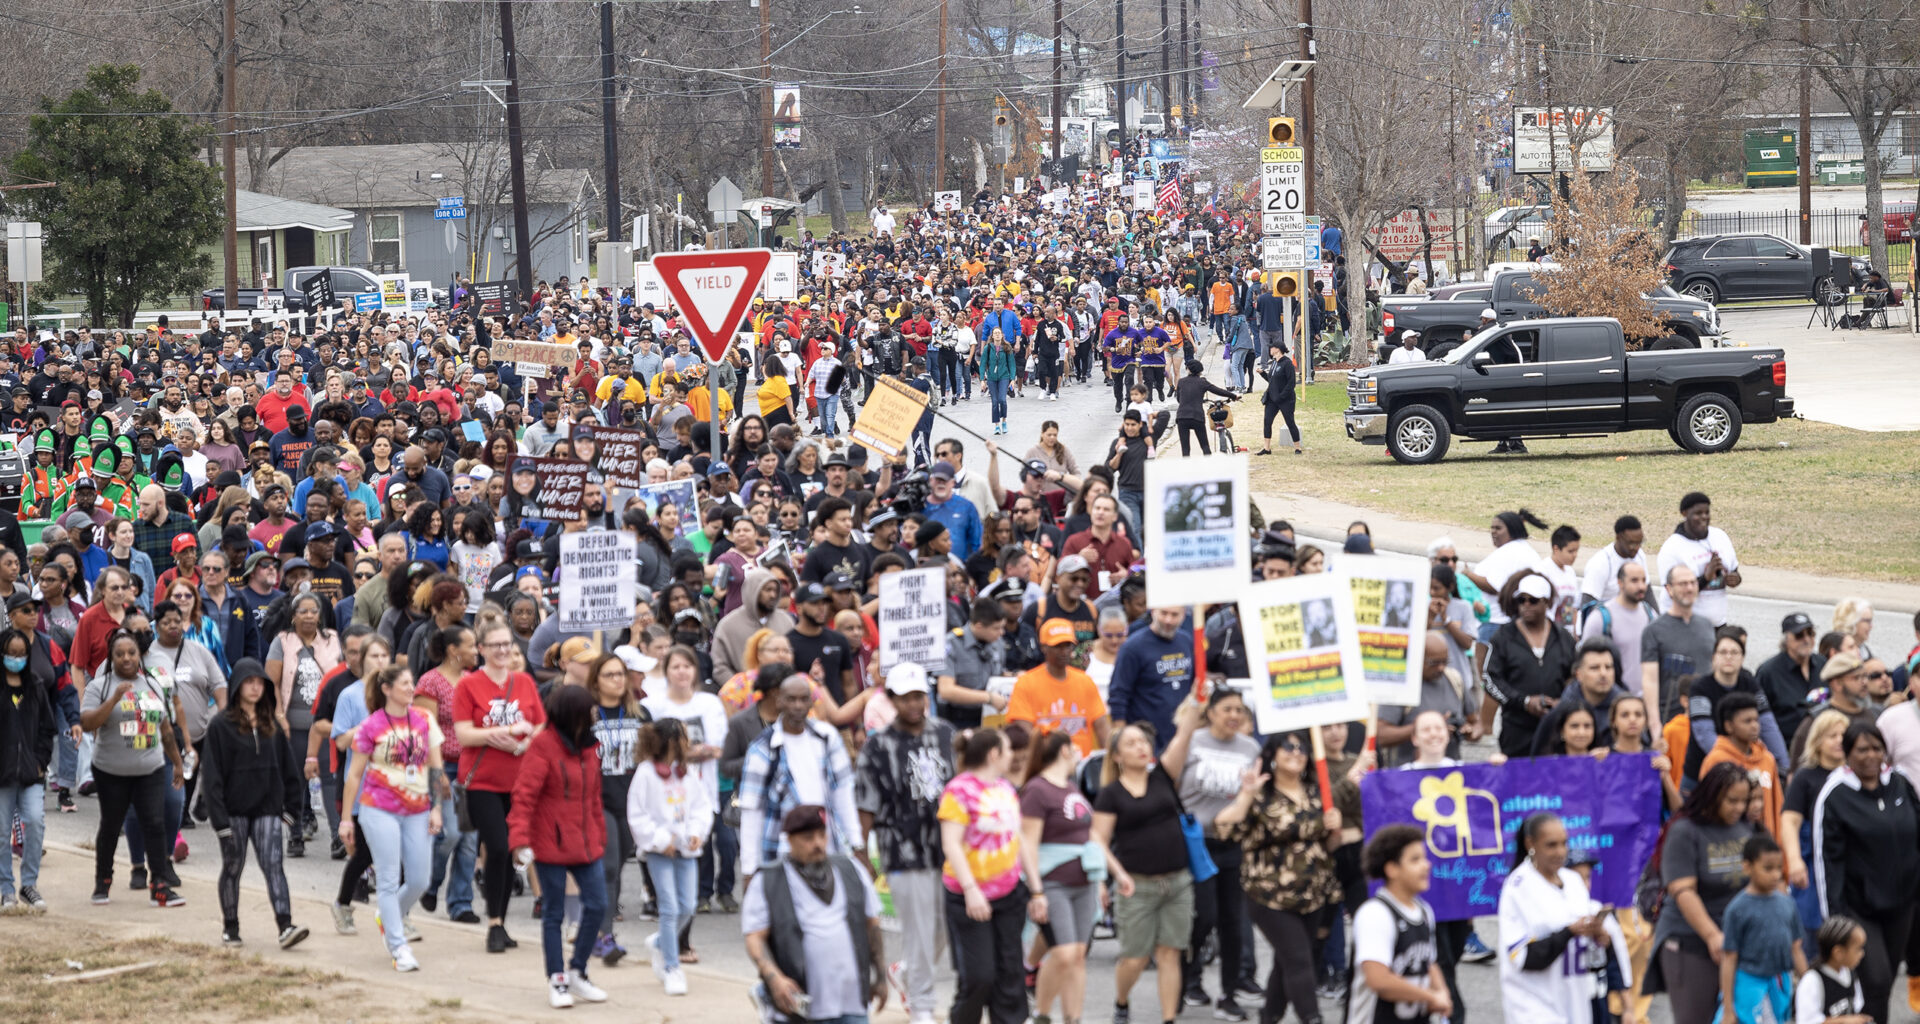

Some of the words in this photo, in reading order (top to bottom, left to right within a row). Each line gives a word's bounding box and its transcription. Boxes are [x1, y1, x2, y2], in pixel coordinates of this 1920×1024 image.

[1264, 150, 1300, 160] SCHOOL
[1266, 165, 1300, 173] SPEED
[1269, 177, 1296, 185] LIMIT
[1268, 189, 1299, 210] 20
[1391, 225, 1408, 234] Title
[694, 276, 732, 289] YIELD
[514, 345, 555, 365] PEACE
[595, 432, 640, 442] REMEMBER
[282, 442, 312, 451] WHISKEY
[603, 443, 637, 457] HER
[537, 464, 588, 473] REMEMBER
[597, 457, 639, 474] NAME!
[544, 475, 583, 489] HER
[586, 472, 604, 484] Eva
[536, 489, 582, 506] NAME!
[521, 506, 540, 517] Eva
[543, 508, 579, 519] Mireles
[579, 535, 617, 549] DEFEND
[563, 549, 632, 565] DEMOCRATIC
[579, 565, 618, 579] RIGHTS!
[900, 575, 926, 588] FIGHT
[1350, 578, 1383, 590] STOP
[582, 584, 617, 595] DEMAND
[588, 597, 617, 607] WHOLE
[905, 590, 921, 603] THE
[1359, 595, 1381, 608] THE
[569, 609, 587, 621] NEW
[592, 607, 627, 619] SYSTEM!
[884, 606, 912, 620] THREE
[917, 603, 942, 618] EVILS
[1260, 604, 1296, 619] STOP
[899, 625, 928, 636] RACISM
[1274, 620, 1299, 634] THE
[890, 638, 934, 650] MILITARISM
[1266, 638, 1302, 652] HATE
[1502, 794, 1563, 812] alpha
